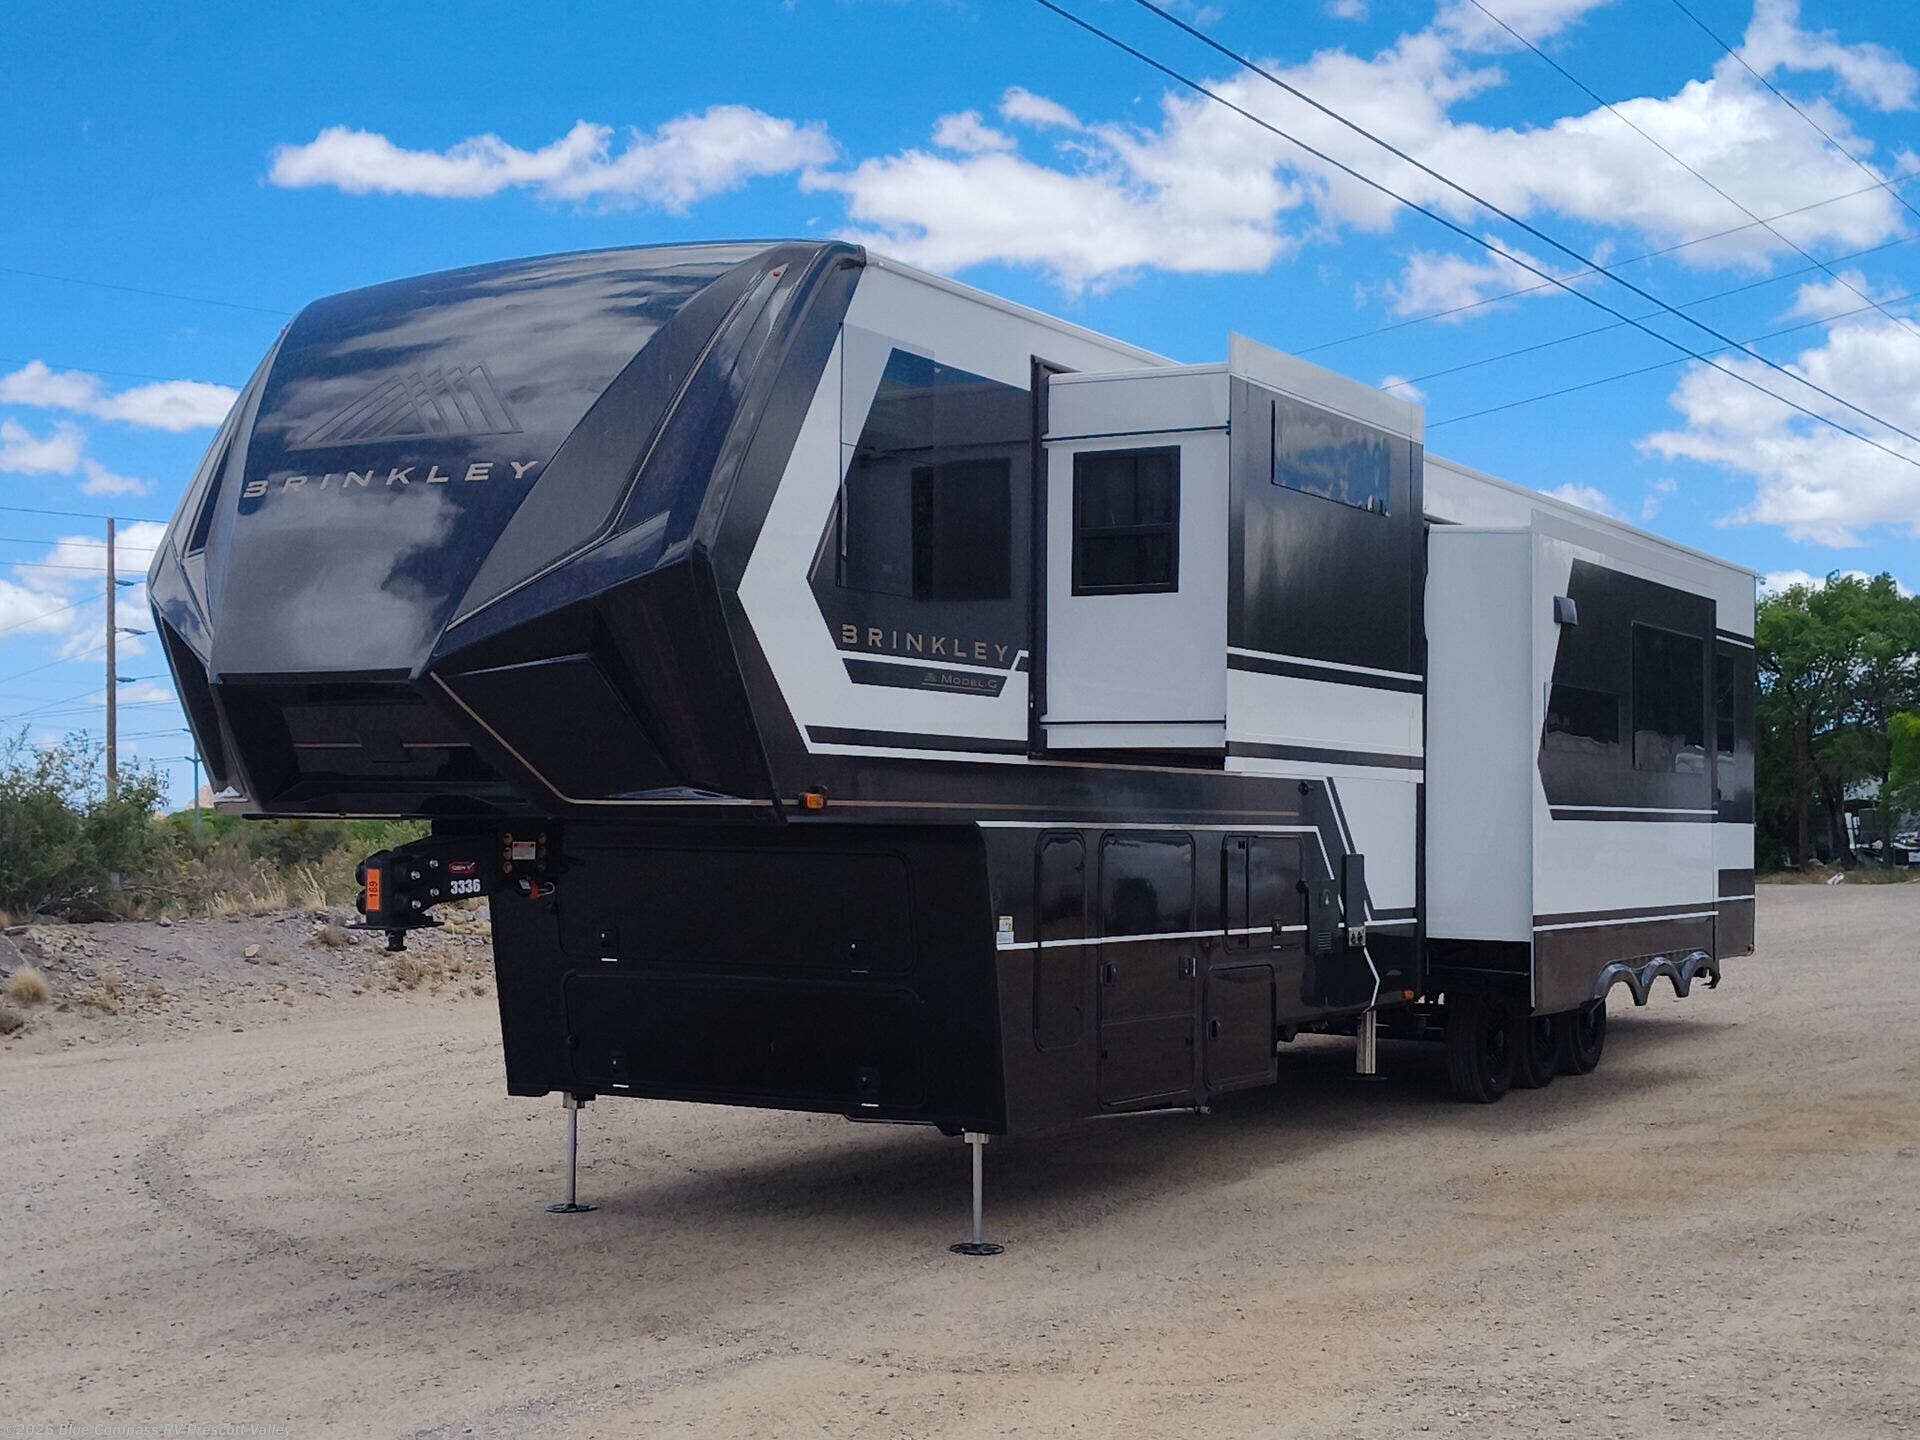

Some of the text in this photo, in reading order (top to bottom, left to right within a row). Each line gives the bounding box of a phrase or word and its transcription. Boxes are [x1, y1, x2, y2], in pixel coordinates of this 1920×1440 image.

[243, 461, 538, 498] BRINKLEY
[842, 623, 1009, 662] BRINKLEY
[450, 878, 481, 894] 3336
